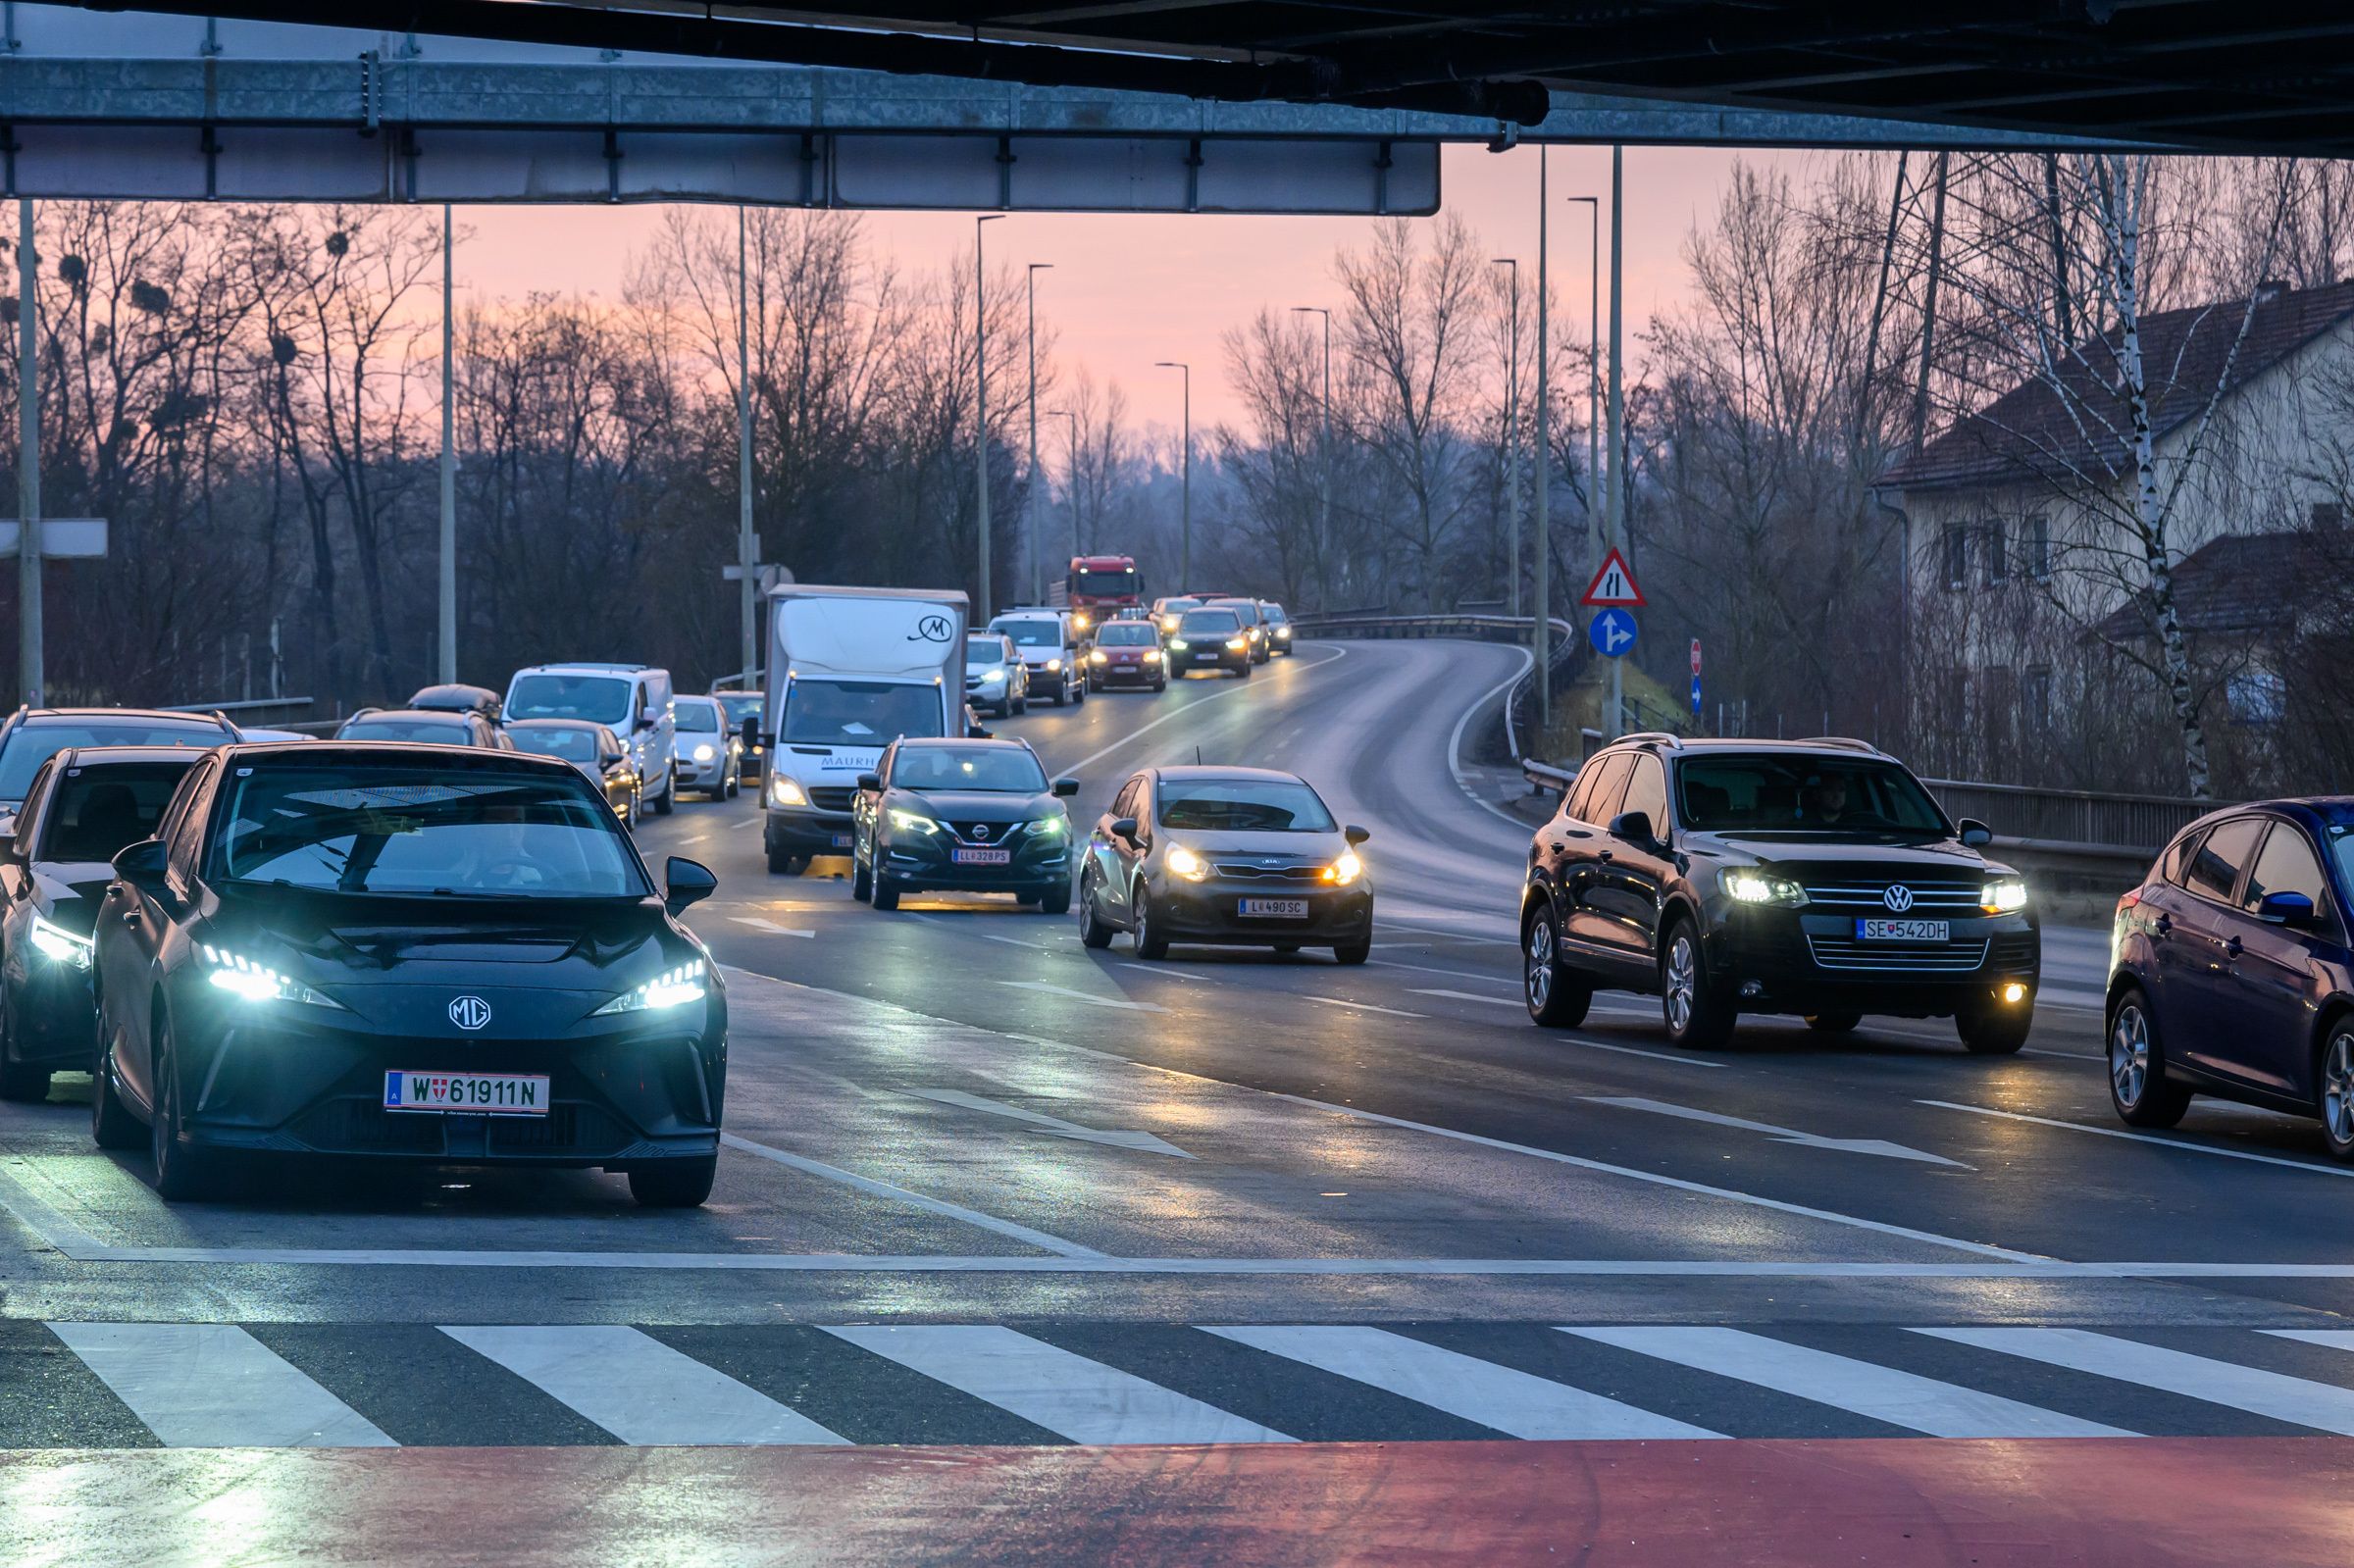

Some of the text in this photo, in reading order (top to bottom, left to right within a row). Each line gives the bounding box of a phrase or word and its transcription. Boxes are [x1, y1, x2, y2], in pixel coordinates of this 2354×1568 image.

[1867, 921, 1947, 939] SE 542DH
[452, 998, 487, 1027] MG
[412, 1077, 431, 1101] W
